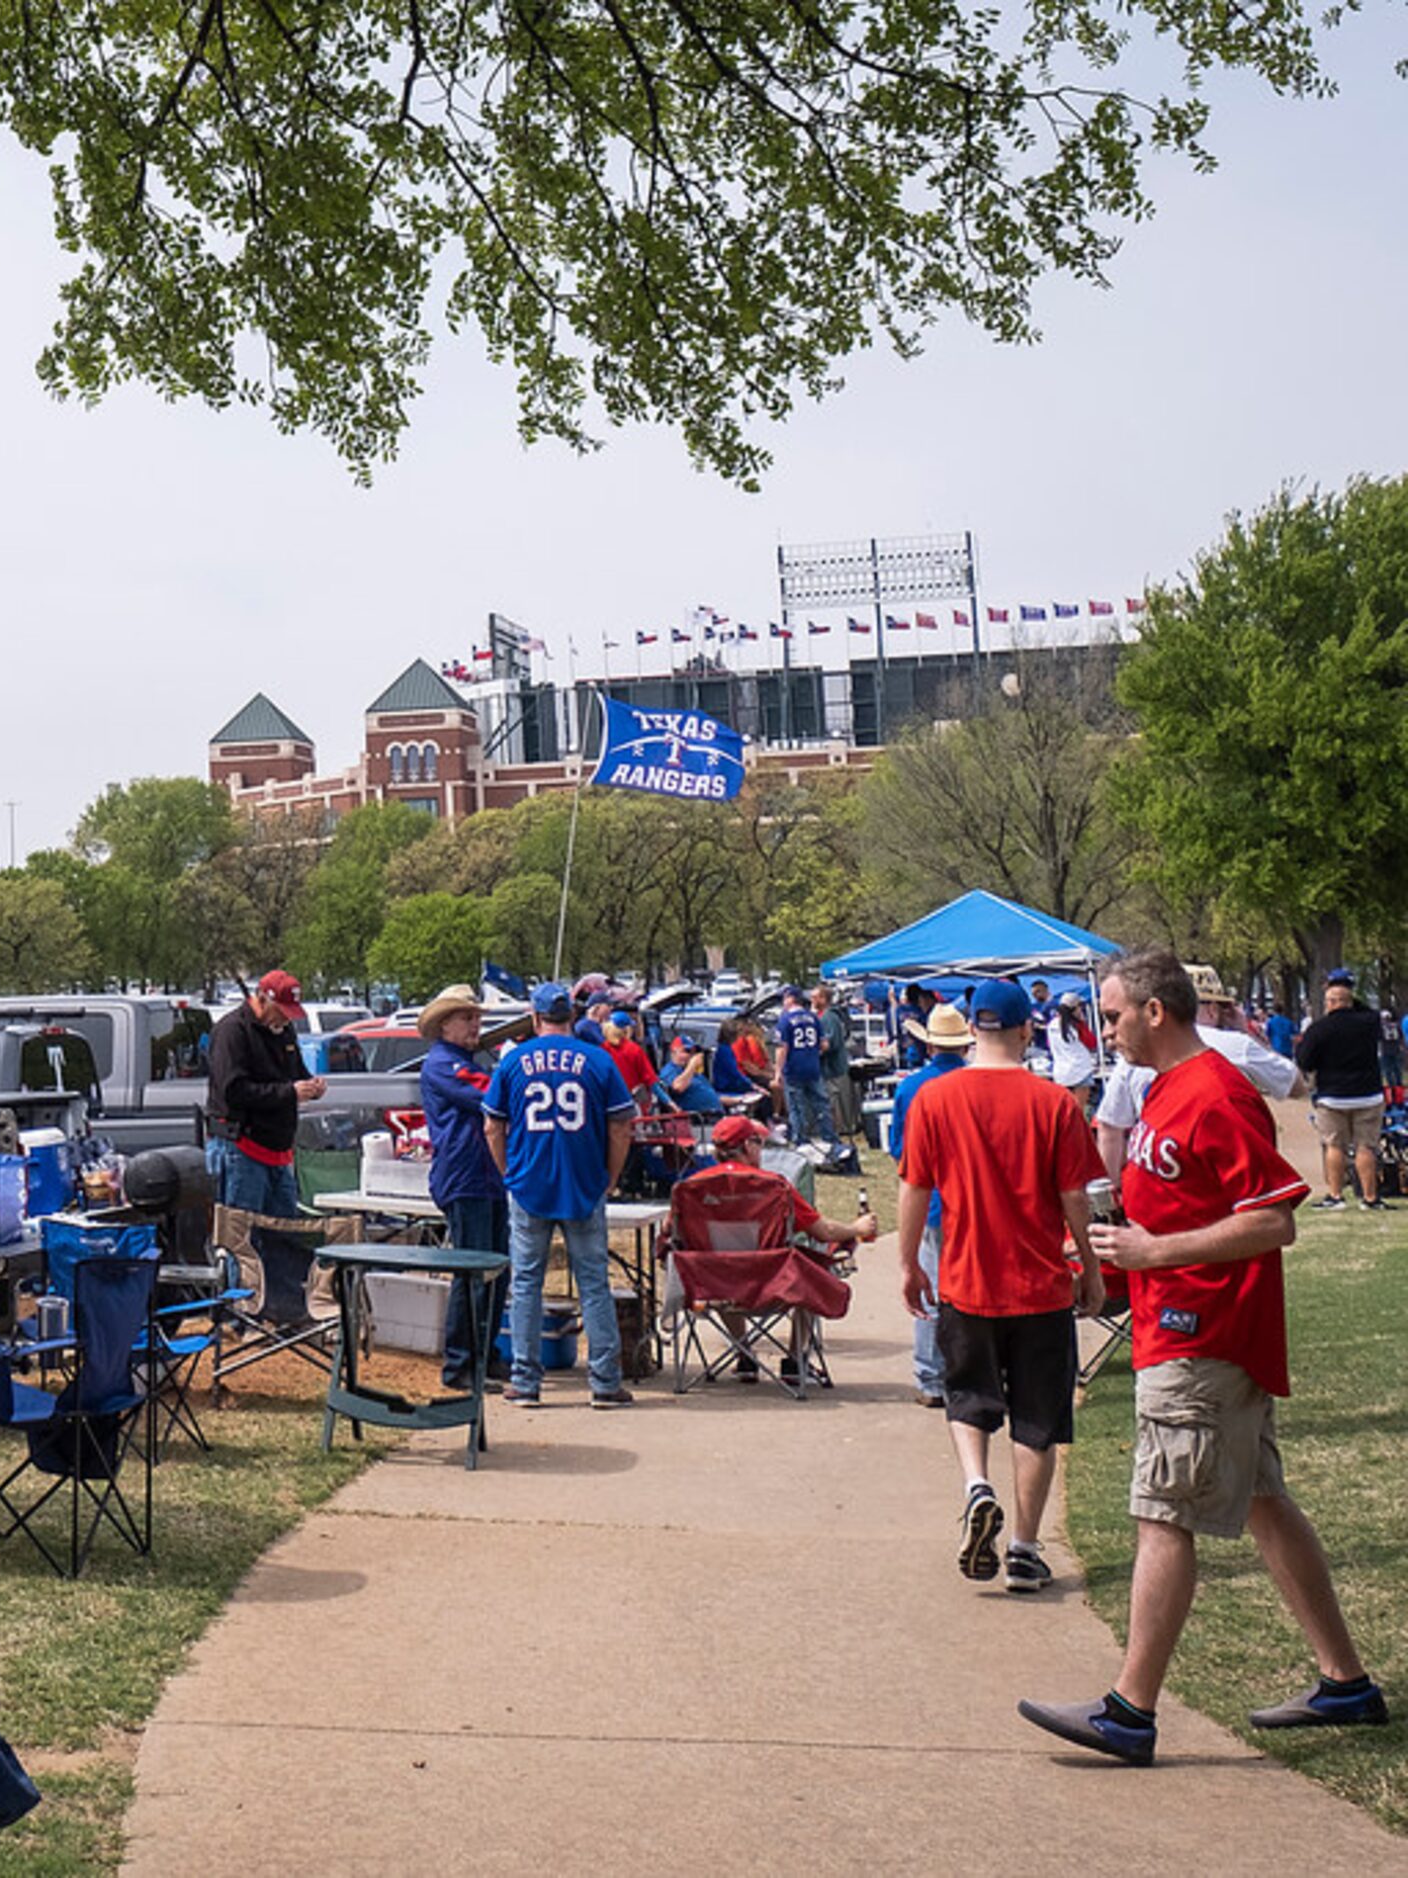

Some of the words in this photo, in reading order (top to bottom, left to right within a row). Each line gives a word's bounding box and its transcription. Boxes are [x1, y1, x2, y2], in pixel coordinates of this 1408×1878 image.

[631, 710, 717, 741] TEXAS
[610, 764, 727, 798] RANGERS
[794, 1027, 817, 1048] 29
[520, 1049, 586, 1076] GREER
[524, 1081, 586, 1132] 29
